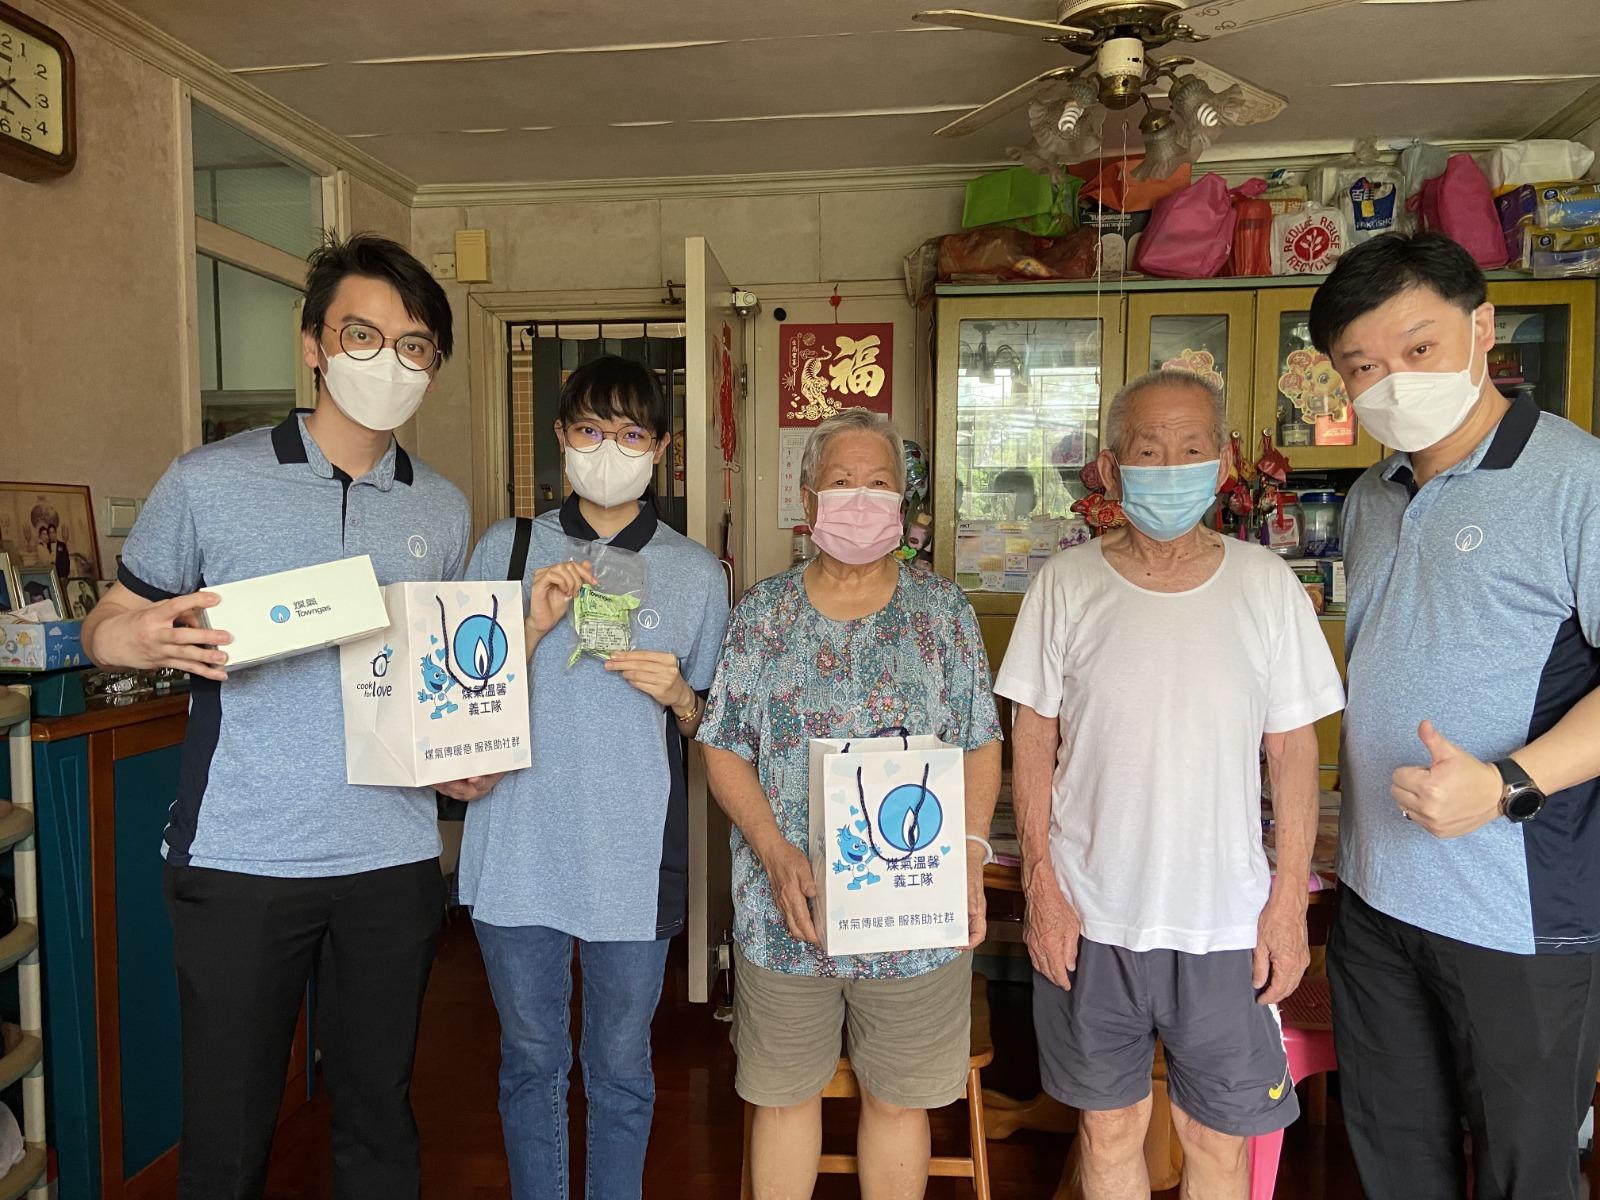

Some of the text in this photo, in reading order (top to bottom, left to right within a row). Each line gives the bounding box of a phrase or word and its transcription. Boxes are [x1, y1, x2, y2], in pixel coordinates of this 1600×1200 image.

[20, 43, 26, 57] 1
[36, 63, 48, 80] 2
[38, 94, 49, 109] 3
[0, 118, 12, 133] 6
[36, 121, 48, 135] 4
[20, 127, 32, 142] 5
[1320, 216, 1340, 249] REUSE
[829, 335, 885, 397] 福
[295, 605, 332, 618] Towngas
[356, 681, 373, 690] cook
[372, 681, 393, 697] love
[468, 700, 502, 716] 義工隊
[474, 736, 520, 753] 服務助社群
[893, 873, 934, 888] 義工隊
[898, 912, 955, 926] 服務助社群
